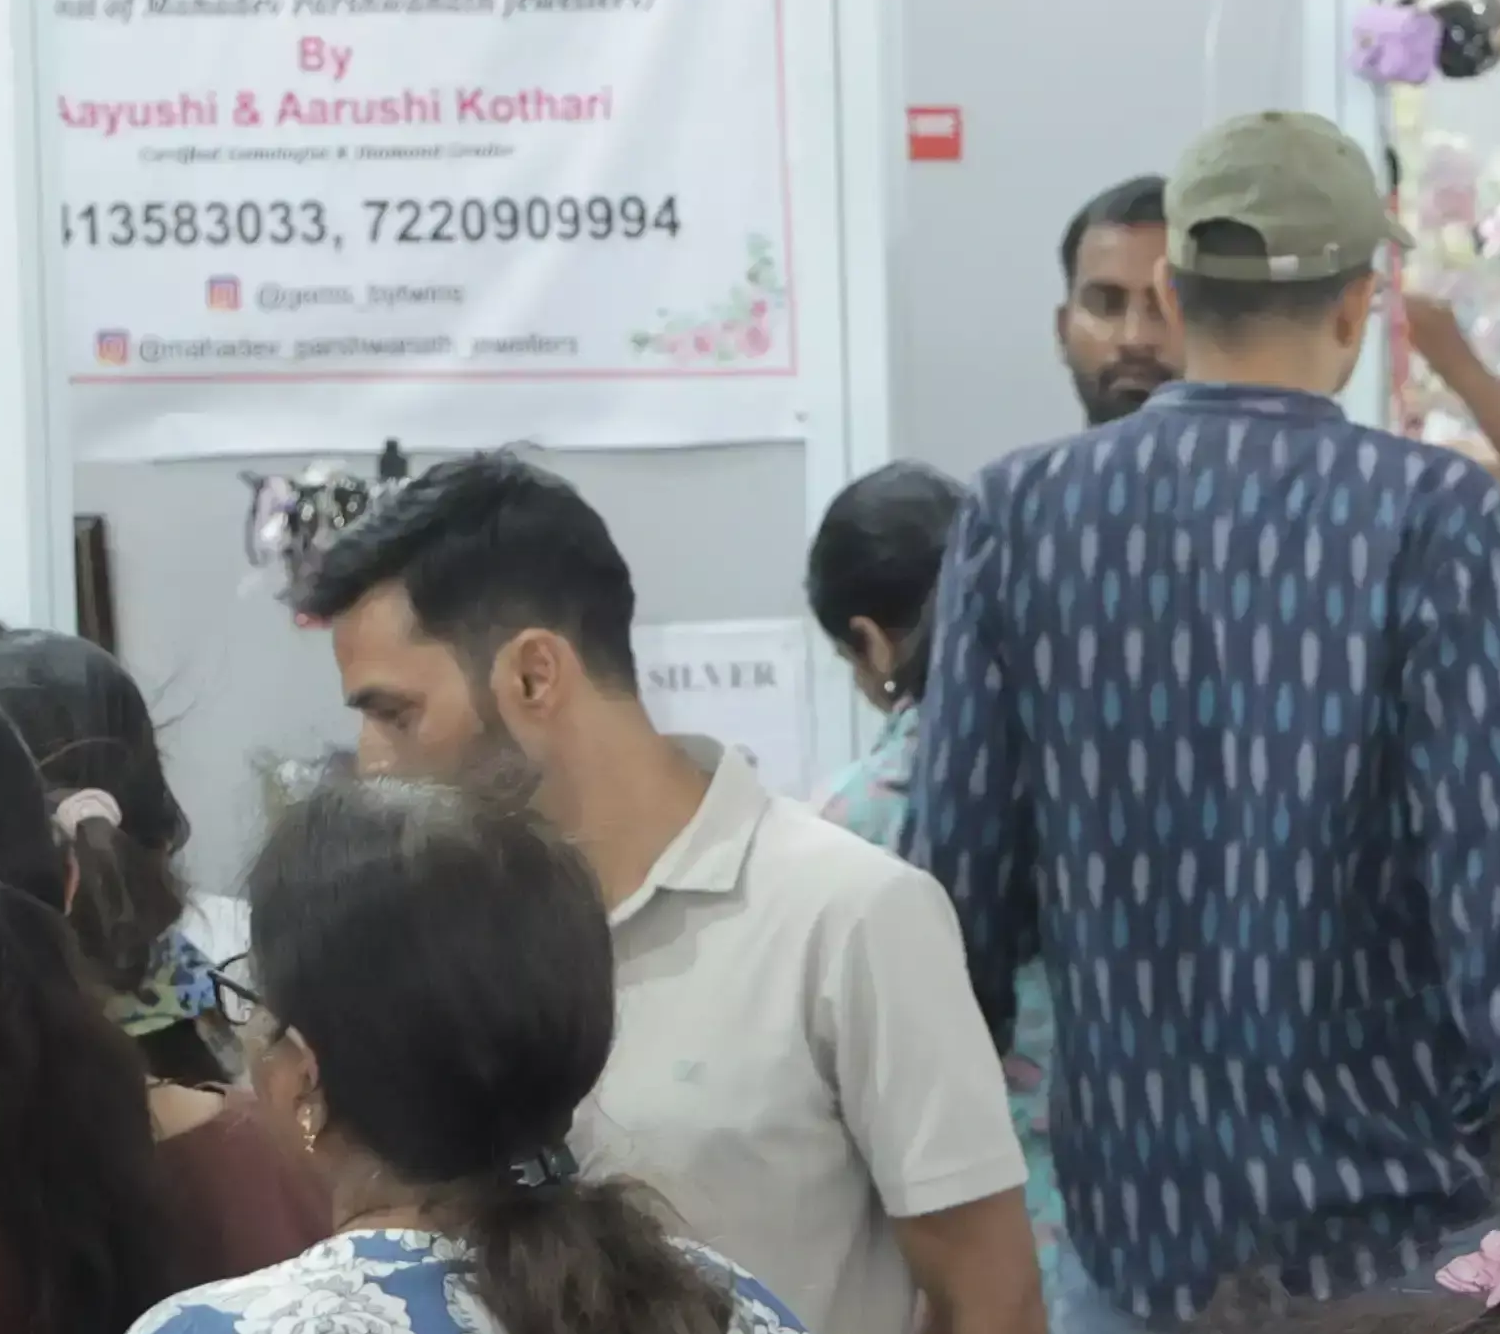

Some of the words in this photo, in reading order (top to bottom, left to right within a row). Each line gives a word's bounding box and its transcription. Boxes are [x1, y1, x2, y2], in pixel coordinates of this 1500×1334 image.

[298, 36, 353, 81] By
[232, 90, 263, 127] &
[275, 88, 441, 127] Aarushi
[457, 85, 612, 123] Kothari
[363, 195, 681, 244] 7220909994
[649, 662, 777, 693] SILVER
